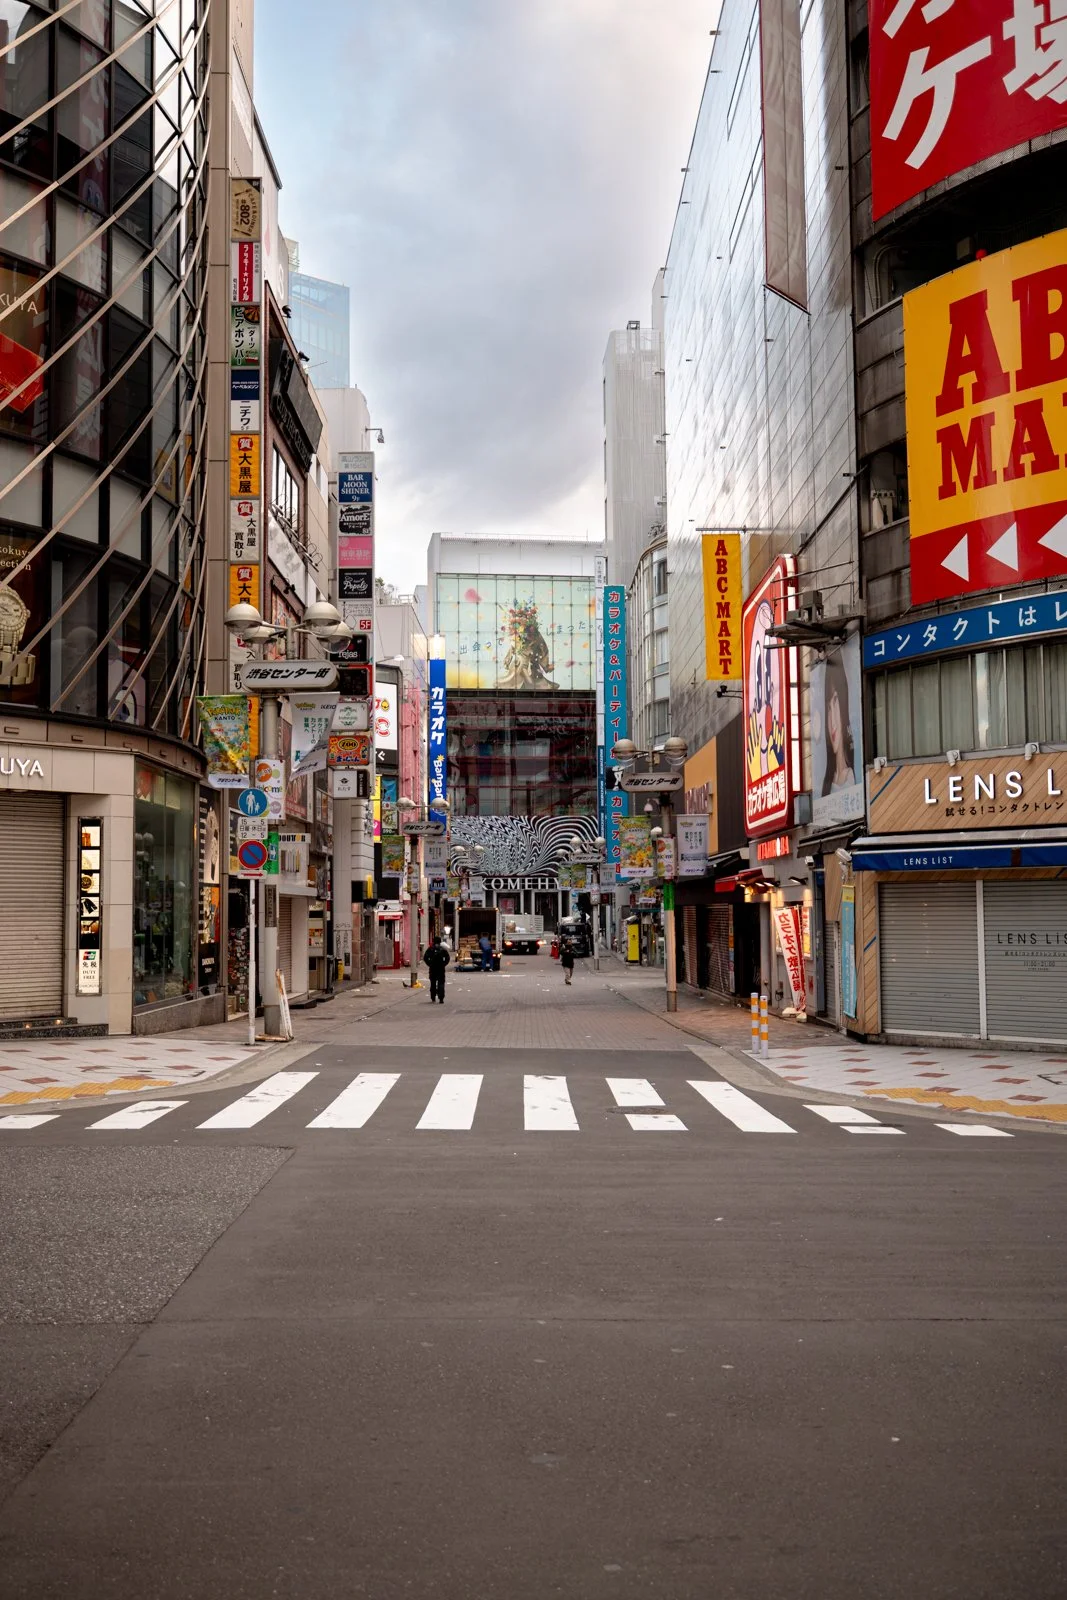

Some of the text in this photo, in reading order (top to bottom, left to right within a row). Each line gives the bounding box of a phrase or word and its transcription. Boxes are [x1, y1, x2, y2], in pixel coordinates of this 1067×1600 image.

[239, 453, 252, 493] 大黒屋
[247, 518, 256, 547] 大黒屋
[234, 532, 244, 559] 買取り
[360, 620, 371, 630] 5F
[246, 667, 331, 679] 渋谷センター街
[431, 686, 444, 745] カラオケ
[625, 777, 680, 786] 渋谷センター街
[924, 771, 1023, 804] LENS
[904, 857, 928, 866] LENS
[997, 932, 1037, 945] LENS
